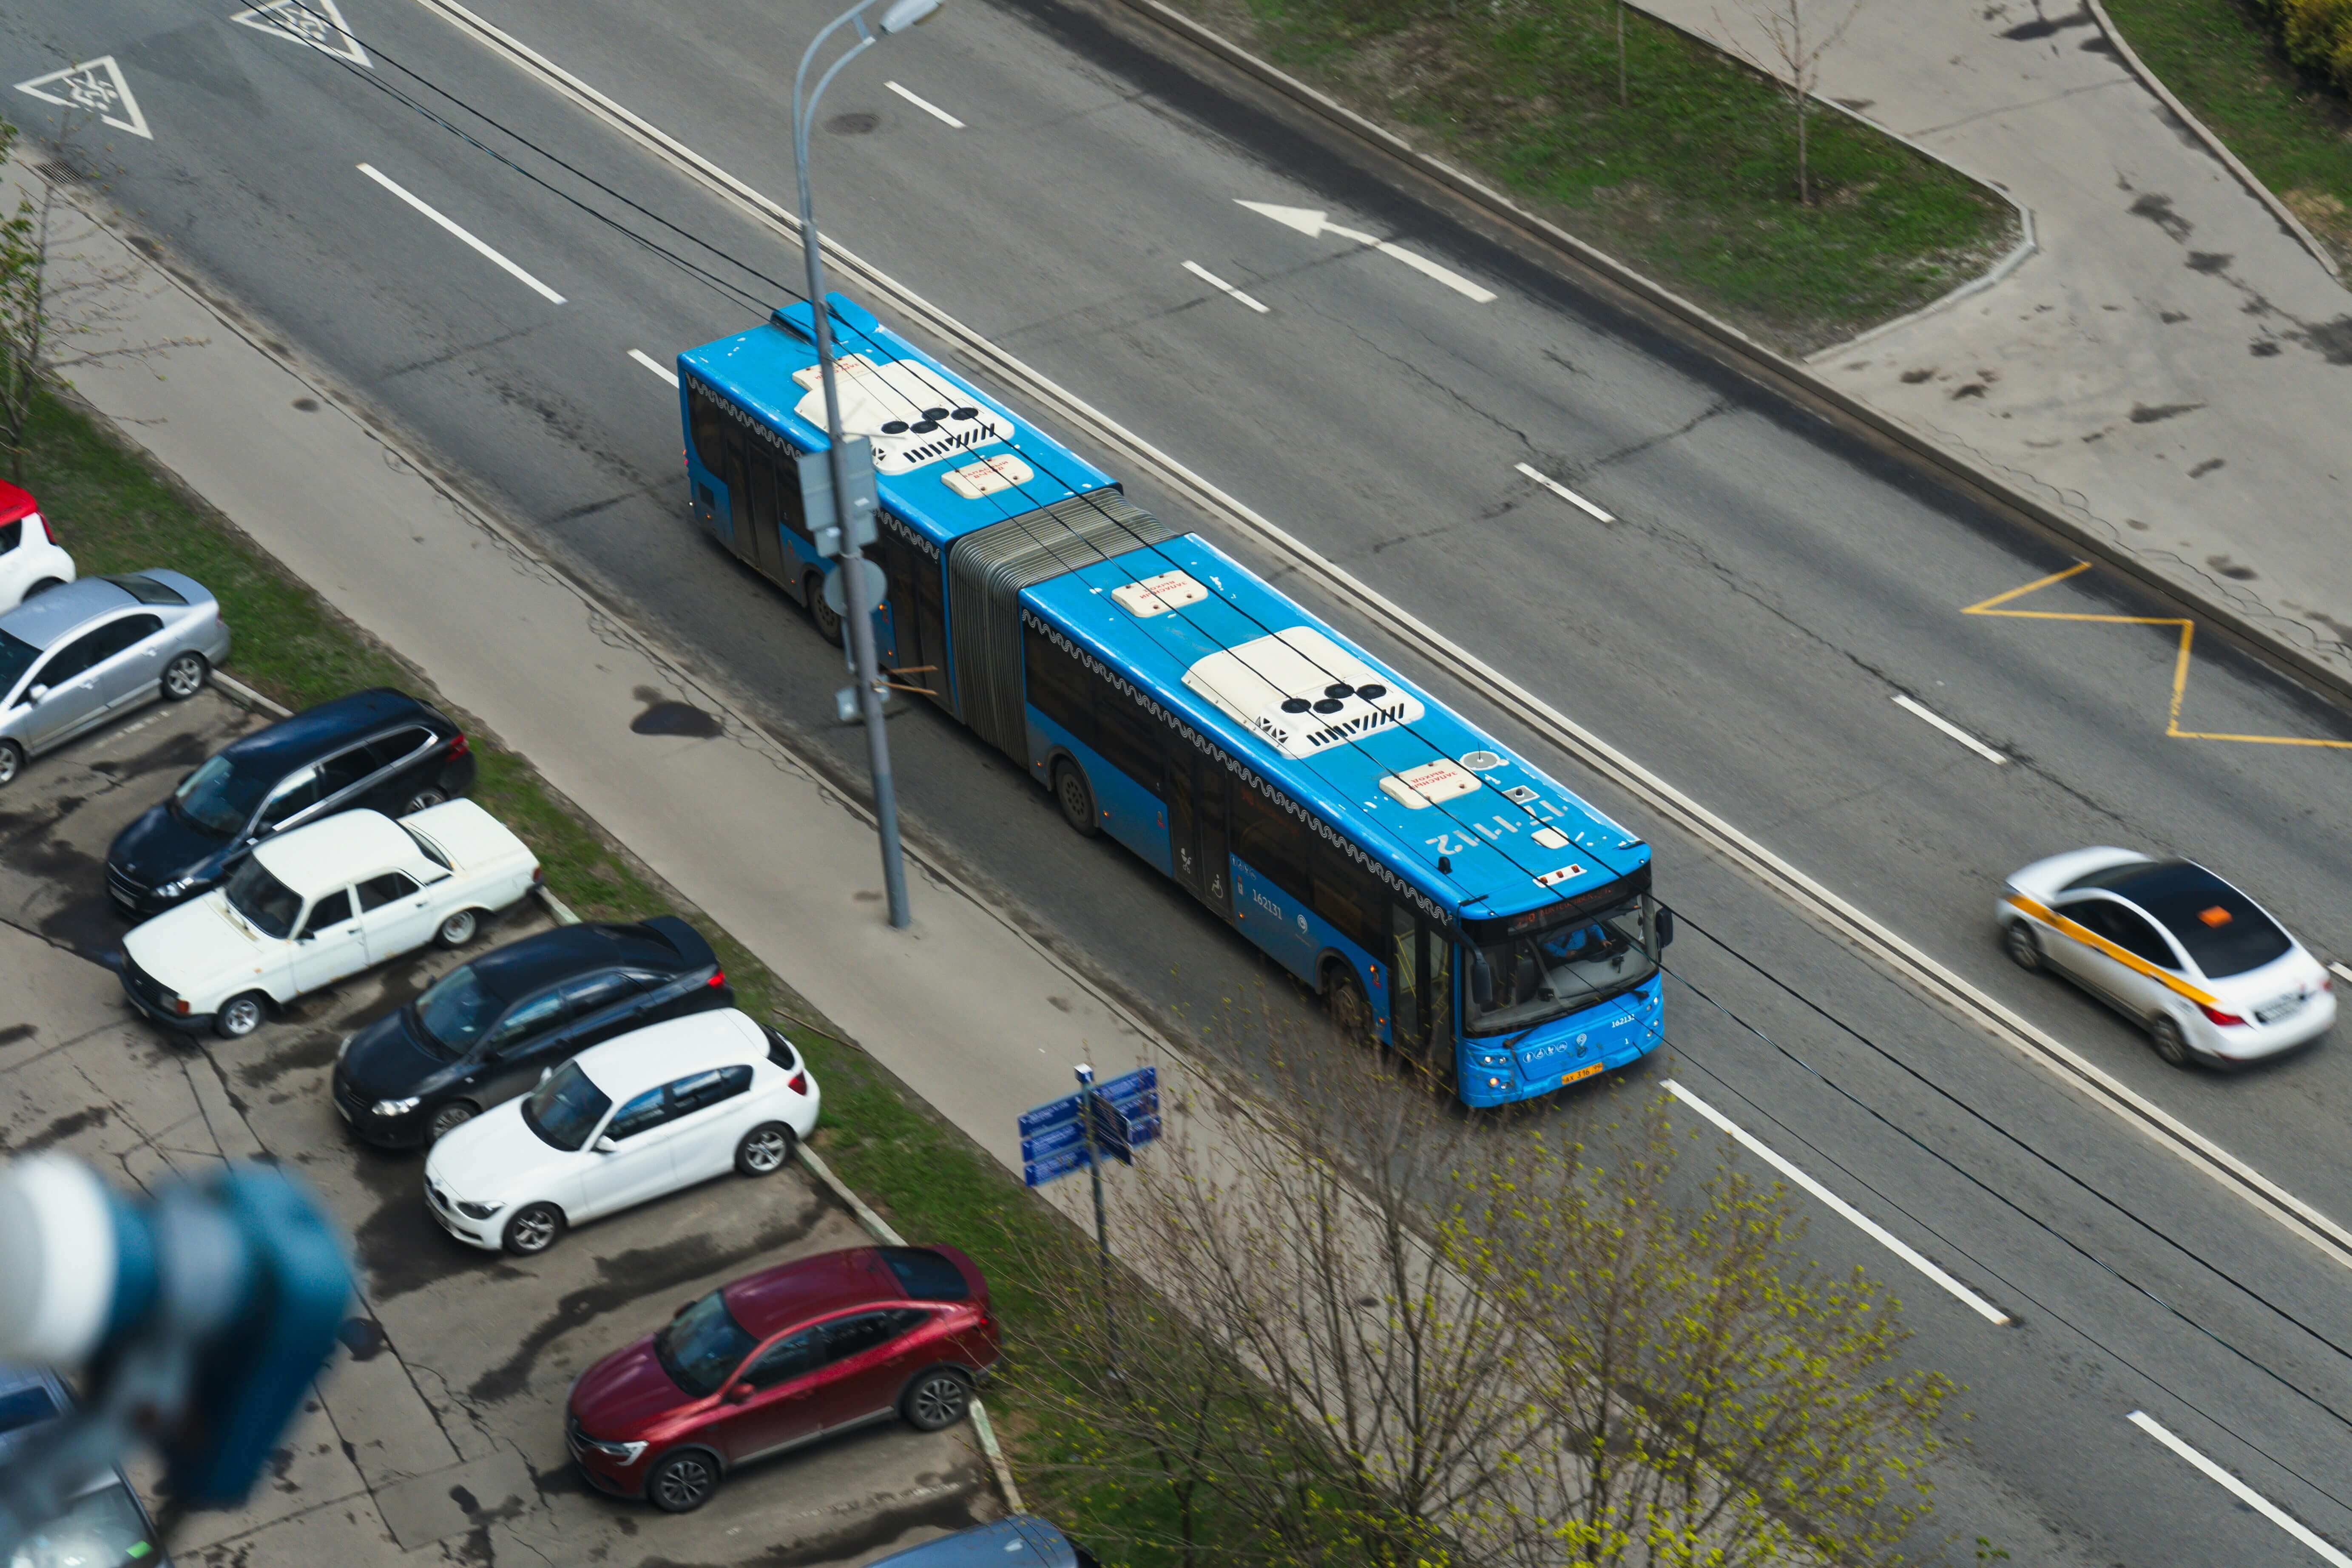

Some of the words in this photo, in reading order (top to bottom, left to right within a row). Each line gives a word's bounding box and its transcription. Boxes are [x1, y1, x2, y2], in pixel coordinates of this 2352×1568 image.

[963, 460, 1008, 477] ЗАПАСЫЙ
[974, 466, 1004, 479] ВЫХД
[1411, 770, 1445, 783] ВЫХОД
[1253, 889, 1282, 920] 162131
